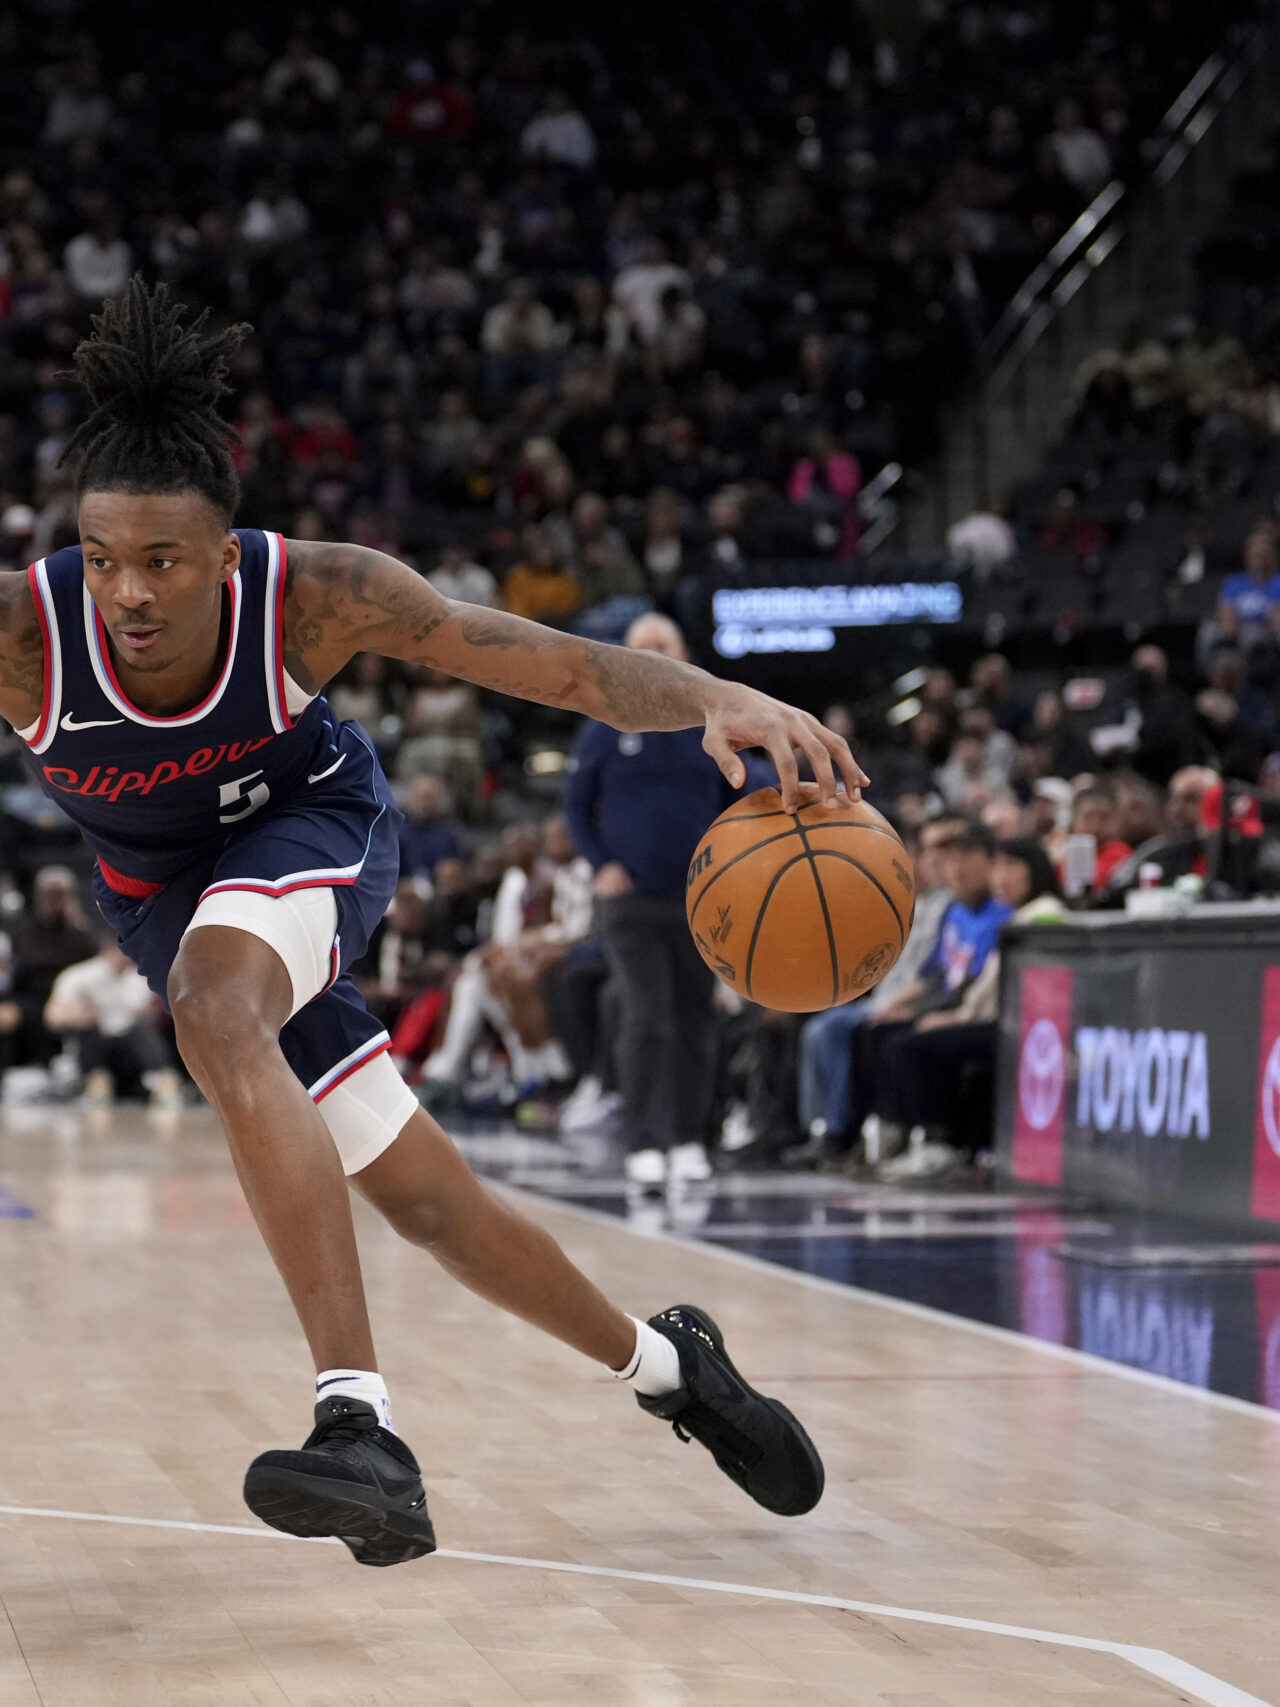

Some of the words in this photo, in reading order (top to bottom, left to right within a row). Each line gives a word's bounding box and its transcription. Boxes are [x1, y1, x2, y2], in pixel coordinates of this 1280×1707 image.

[42, 734, 275, 802] Clippers
[218, 769, 270, 823] 5
[1076, 1026, 1210, 1141] TOYOTA
